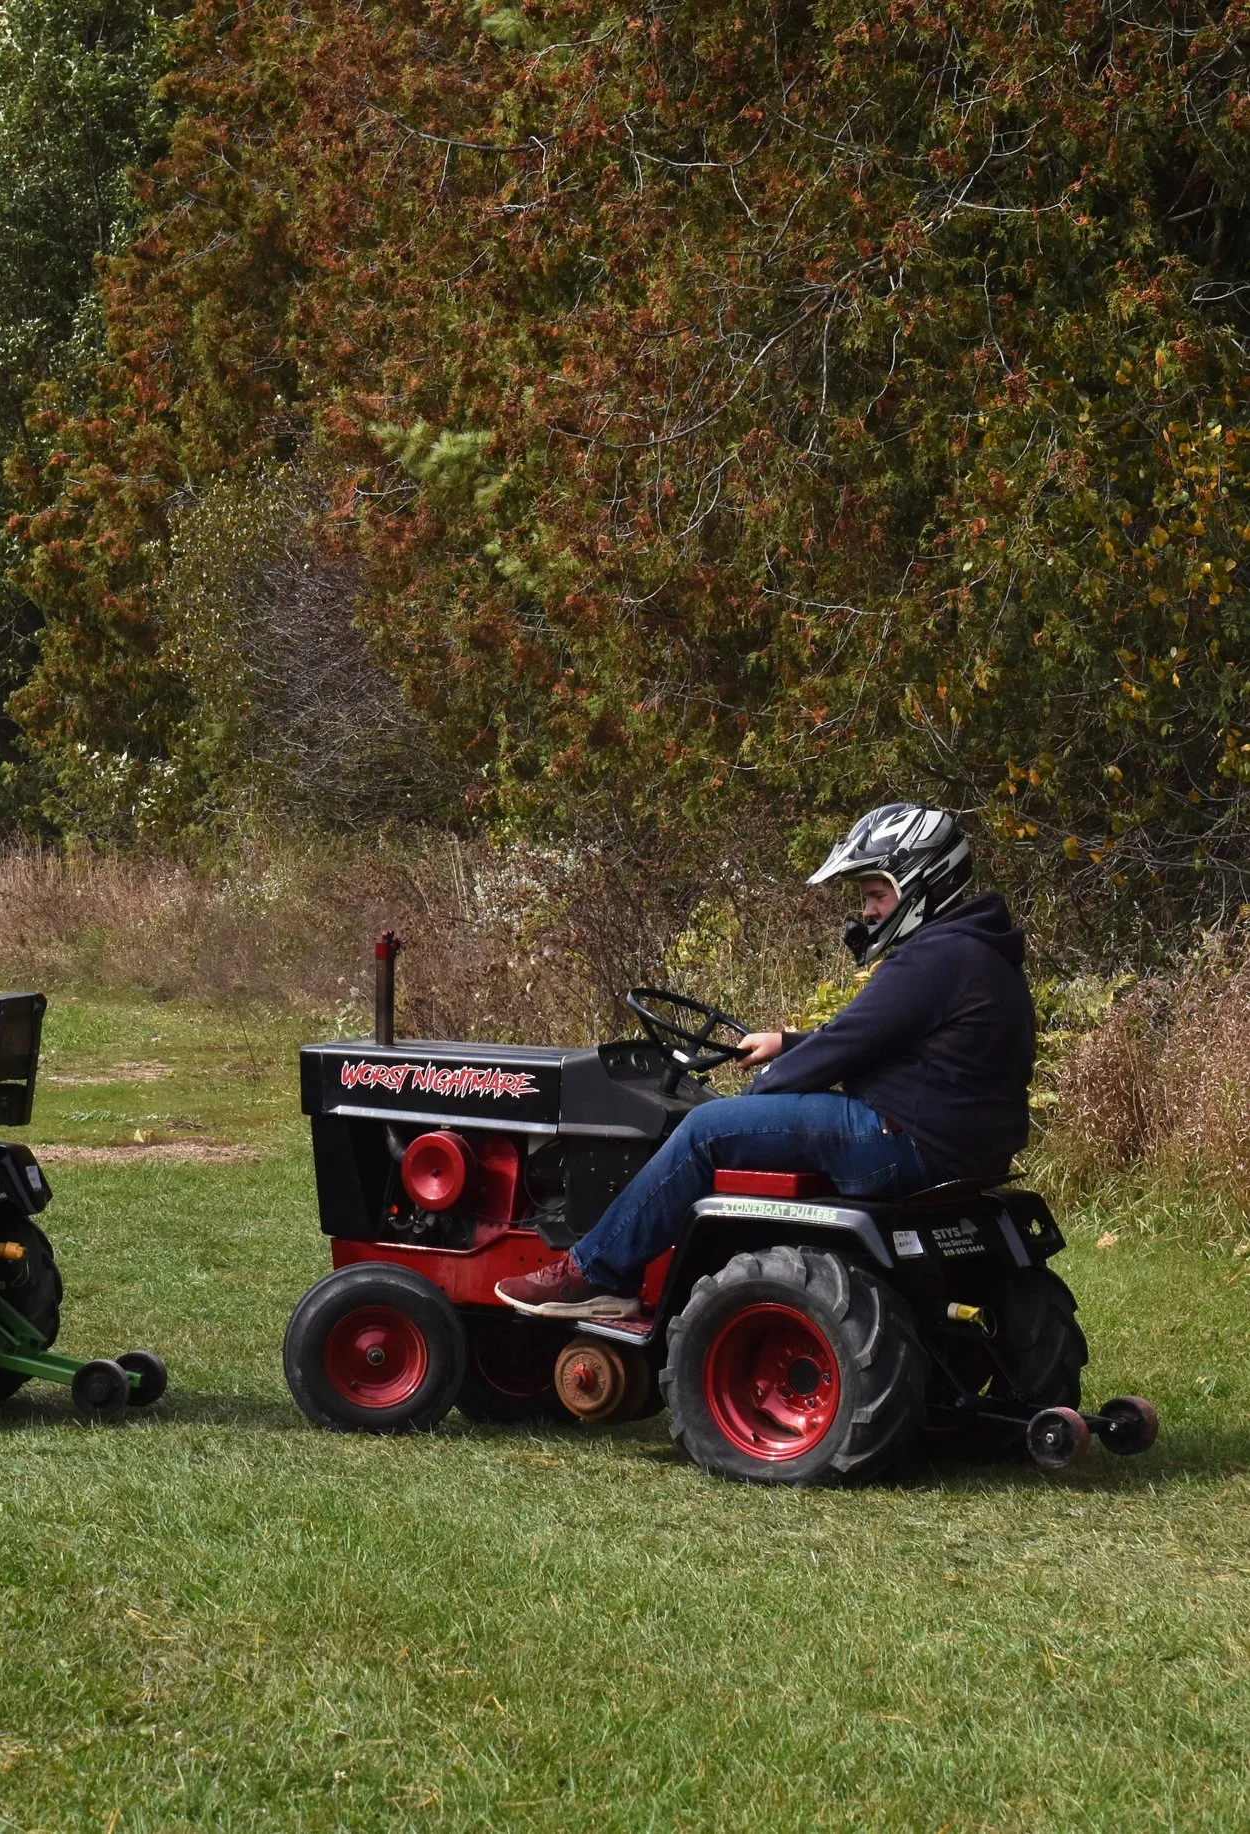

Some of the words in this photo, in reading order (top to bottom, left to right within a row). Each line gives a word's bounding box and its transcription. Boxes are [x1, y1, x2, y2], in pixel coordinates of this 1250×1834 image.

[341, 1060, 425, 1094] WORST
[412, 1061, 540, 1099] NIGHTMARE
[721, 1201, 789, 1217] STONEBOAT
[789, 1207, 838, 1221] PULLERS
[931, 1227, 962, 1240] STYS
